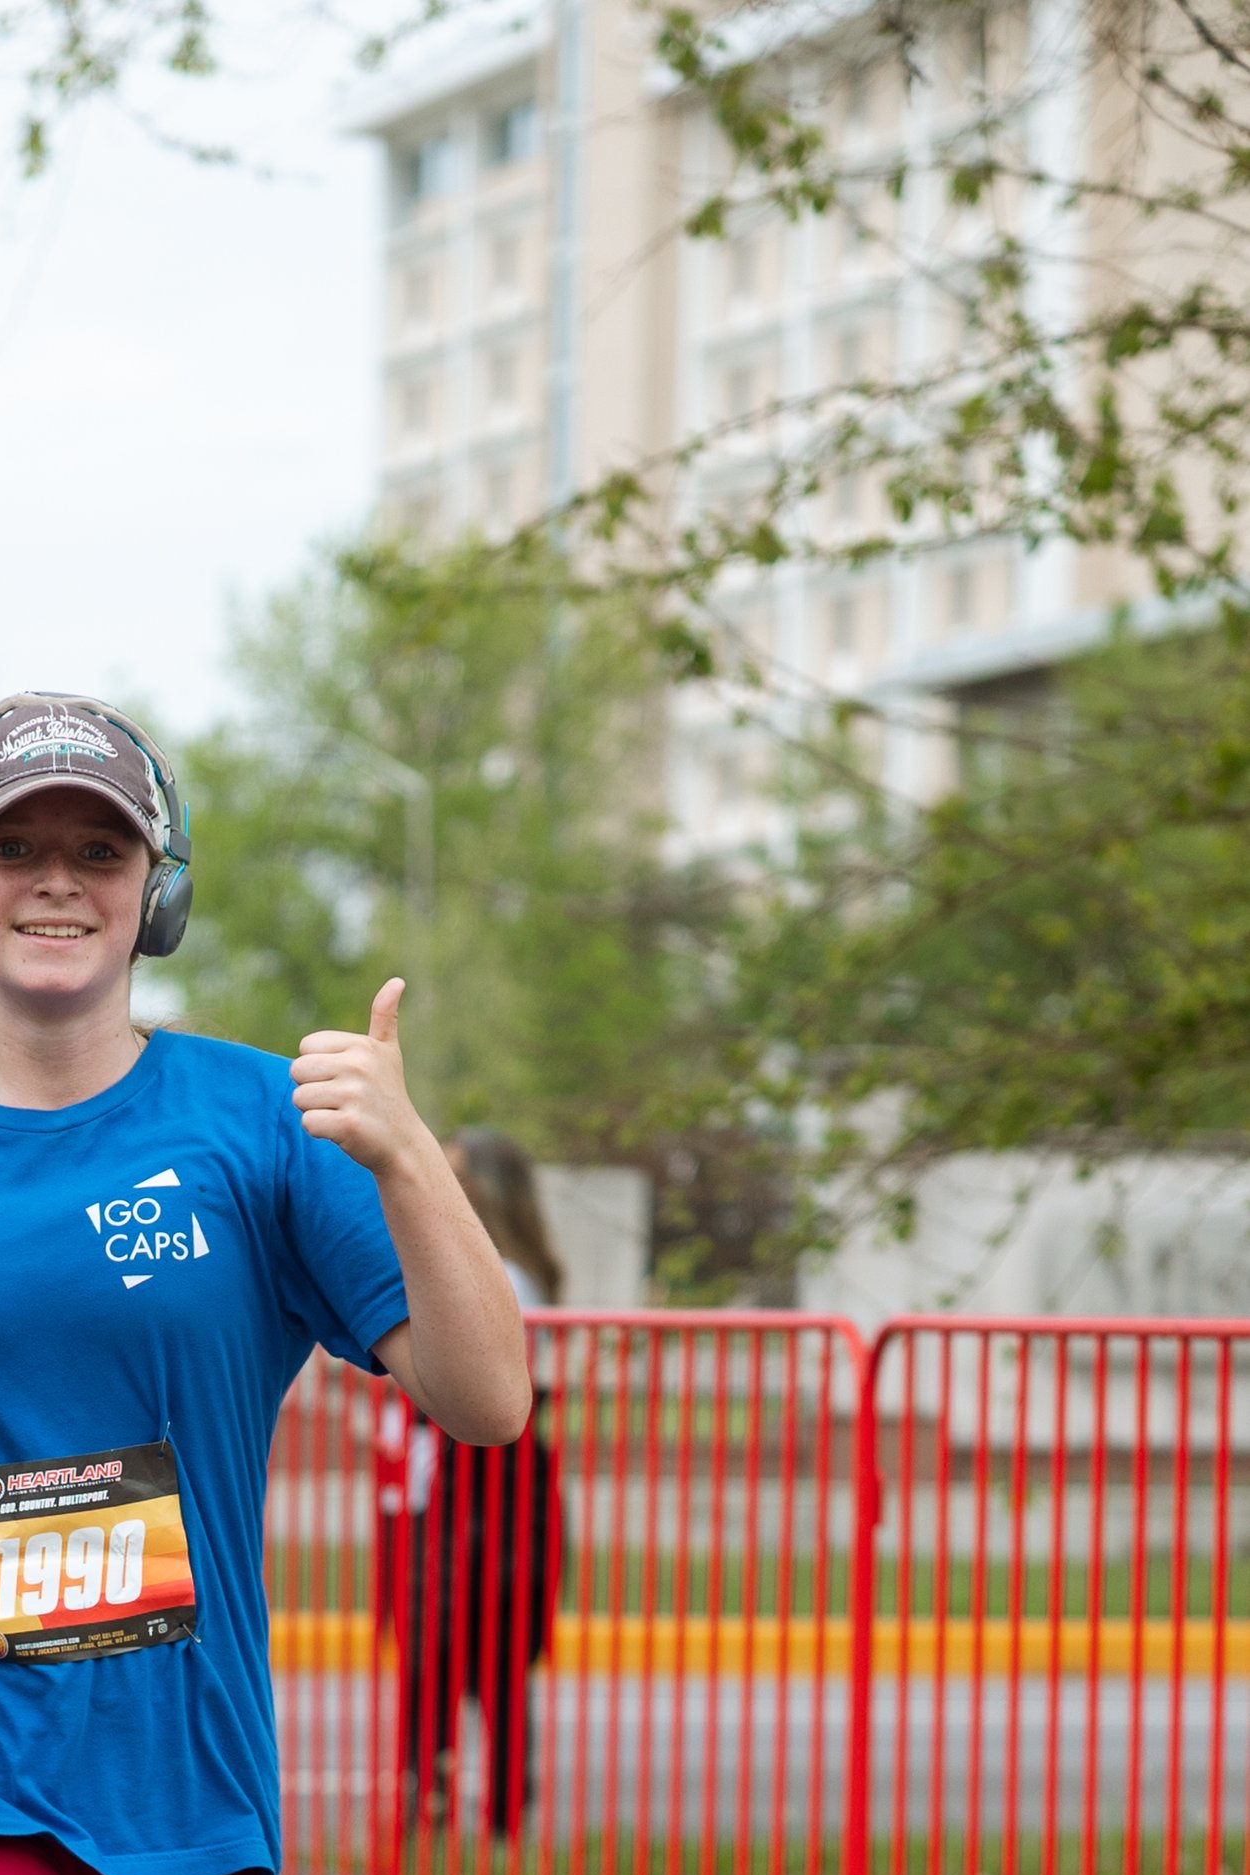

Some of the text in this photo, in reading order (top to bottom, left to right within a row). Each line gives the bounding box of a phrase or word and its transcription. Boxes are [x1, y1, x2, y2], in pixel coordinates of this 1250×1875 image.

[43, 721, 117, 753] Rushmore
[103, 1197, 162, 1227] GO
[105, 1231, 190, 1262] CAPS
[7, 1460, 123, 1491] HEARTLAND
[0, 1490, 110, 1514] GOD. COUNTRY. MULTISPORT.
